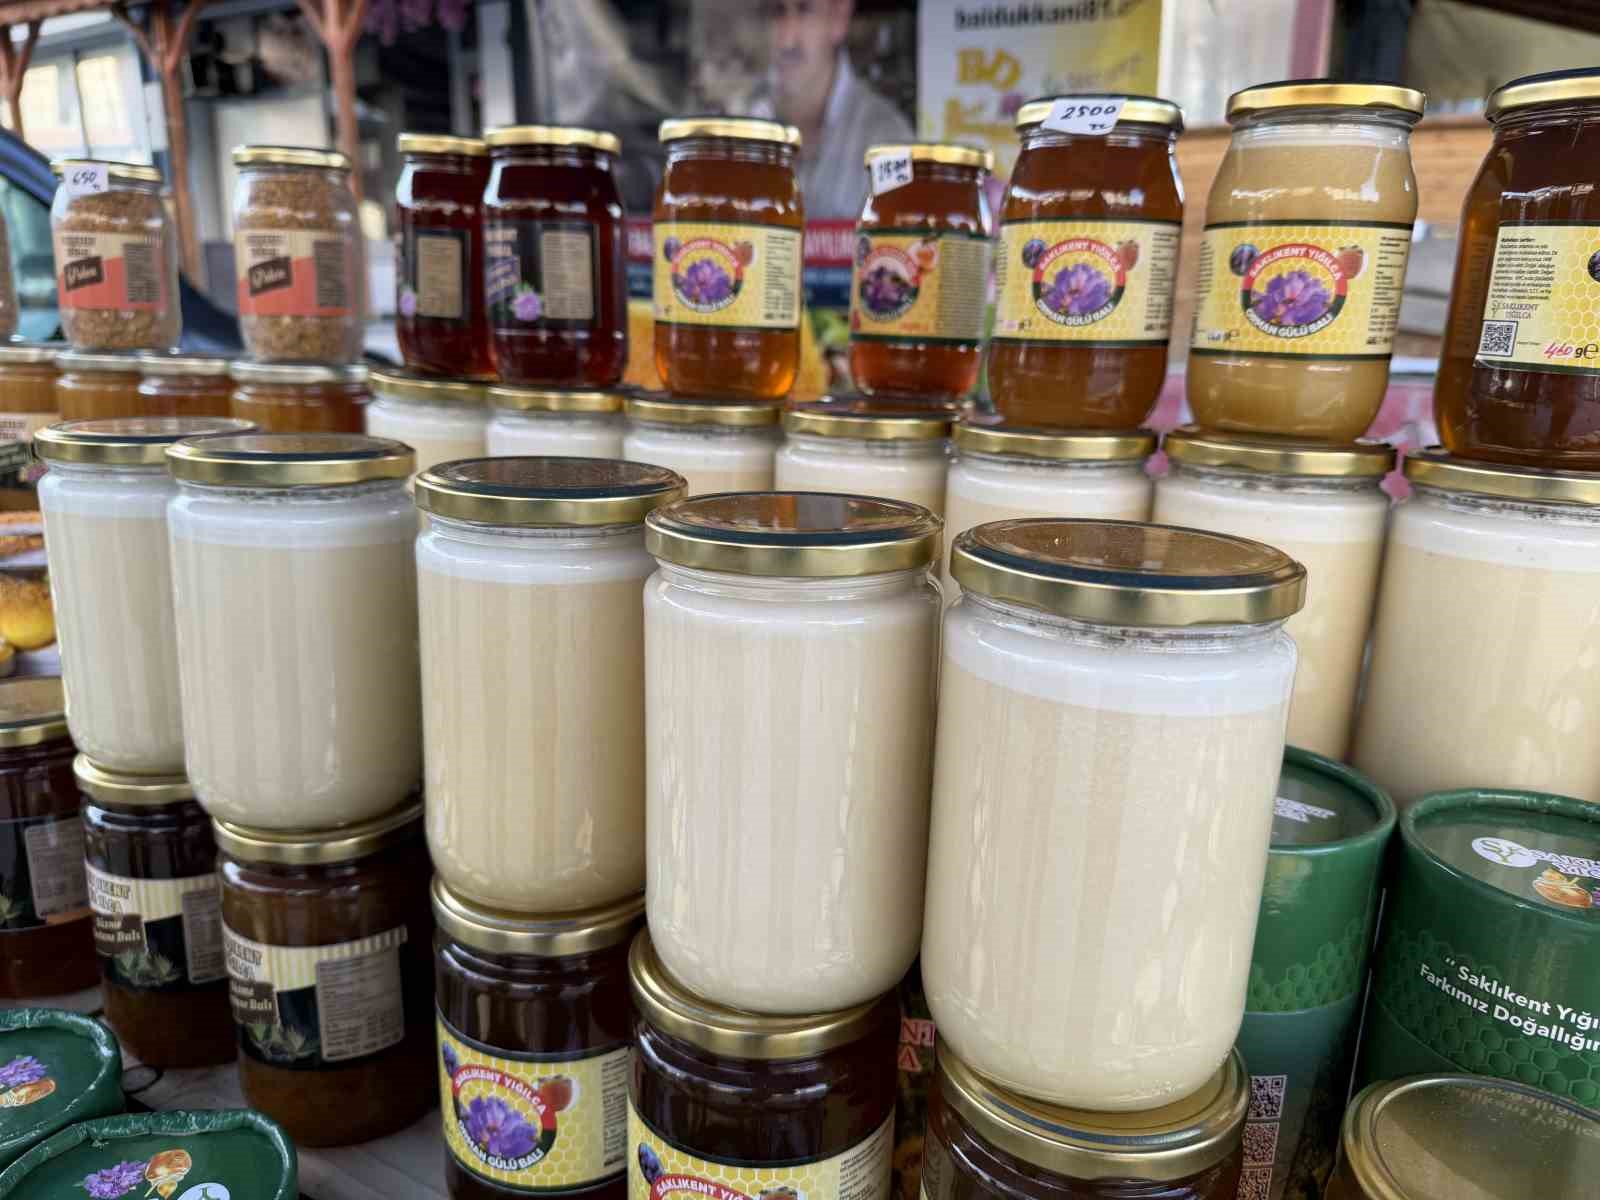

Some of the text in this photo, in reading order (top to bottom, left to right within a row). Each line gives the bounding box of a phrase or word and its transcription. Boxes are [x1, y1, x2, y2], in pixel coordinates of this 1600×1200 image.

[1059, 105, 1117, 121] 2500
[1419, 963, 1490, 1014] Farkımız
[1457, 965, 1552, 1016] Saklıkent
[1556, 1003, 1600, 1031] Yığı
[655, 1177, 715, 1197] SAKLIKENT
